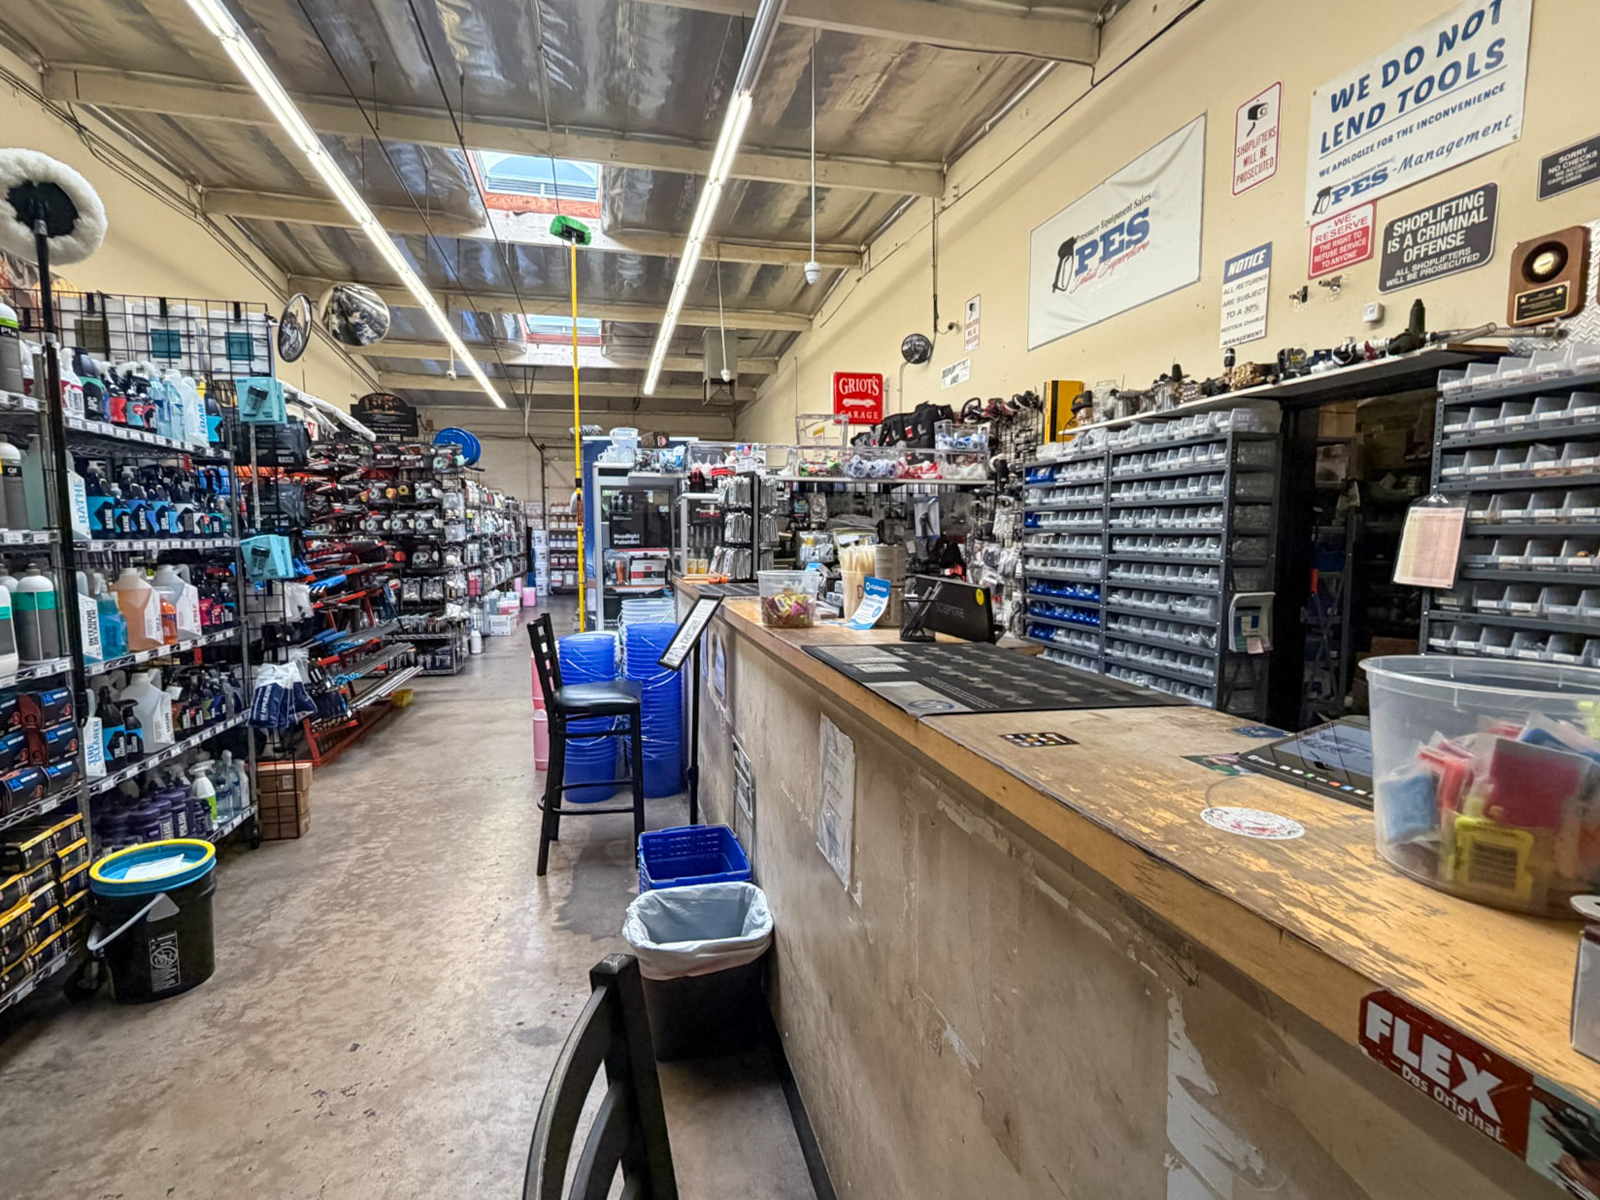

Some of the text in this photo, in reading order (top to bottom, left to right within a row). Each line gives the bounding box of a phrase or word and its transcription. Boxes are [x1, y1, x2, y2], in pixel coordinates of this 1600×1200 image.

[1330, 0, 1503, 113] WE DO NOT
[1320, 37, 1506, 154] LEND TOOLS
[1236, 125, 1277, 158] SHOPLIFTERS
[1318, 168, 1331, 178] WE
[1331, 145, 1376, 172] APOLOGIZE
[1376, 134, 1394, 149] FOR
[1396, 124, 1414, 140] THE
[1416, 81, 1506, 131] INCONVENIENCE
[1243, 145, 1268, 168] WILL BE
[1548, 150, 1598, 175] NO CHECKS
[1558, 146, 1589, 163] SORRY
[1236, 156, 1275, 186] PROSECUTED
[1331, 166, 1389, 206] PES
[1393, 190, 1485, 237] SHOPLIFTING
[1074, 206, 1150, 278] PES
[1315, 215, 1369, 243] RESERVE
[1319, 230, 1363, 253] THE RIGHT TO
[1387, 206, 1489, 254] IS A CRIMINAL
[1314, 237, 1367, 263] REFUSE SERVICE
[1321, 250, 1358, 269] TO ANYONE
[1394, 246, 1472, 277] ALL SHOPLIFTERS
[1403, 230, 1466, 264] OFFENSE
[1227, 249, 1268, 277] NOTICE
[1386, 252, 1480, 288] WILL BE PROSECUTED
[1222, 287, 1267, 308] ARE SUBJECT
[1223, 273, 1268, 295] ALL RETURNS
[1221, 322, 1243, 333] RESTOCK
[1226, 310, 1236, 320] TO
[1236, 308, 1242, 316] A
[1222, 329, 1264, 346] MANAGEMENT
[839, 376, 880, 396] GRIOT'S
[86, 396, 98, 412] APC
[197, 403, 207, 434] FOAM
[73, 479, 87, 524] BATHE
[86, 610, 94, 647] INTERIOR
[90, 609, 99, 646] DETAILER
[86, 743, 95, 766] TIRE
[93, 720, 102, 763] CLEANER
[177, 811, 189, 837] POLISH
[1365, 1000, 1503, 1124] FLEX
[1433, 1088, 1503, 1144] Original
